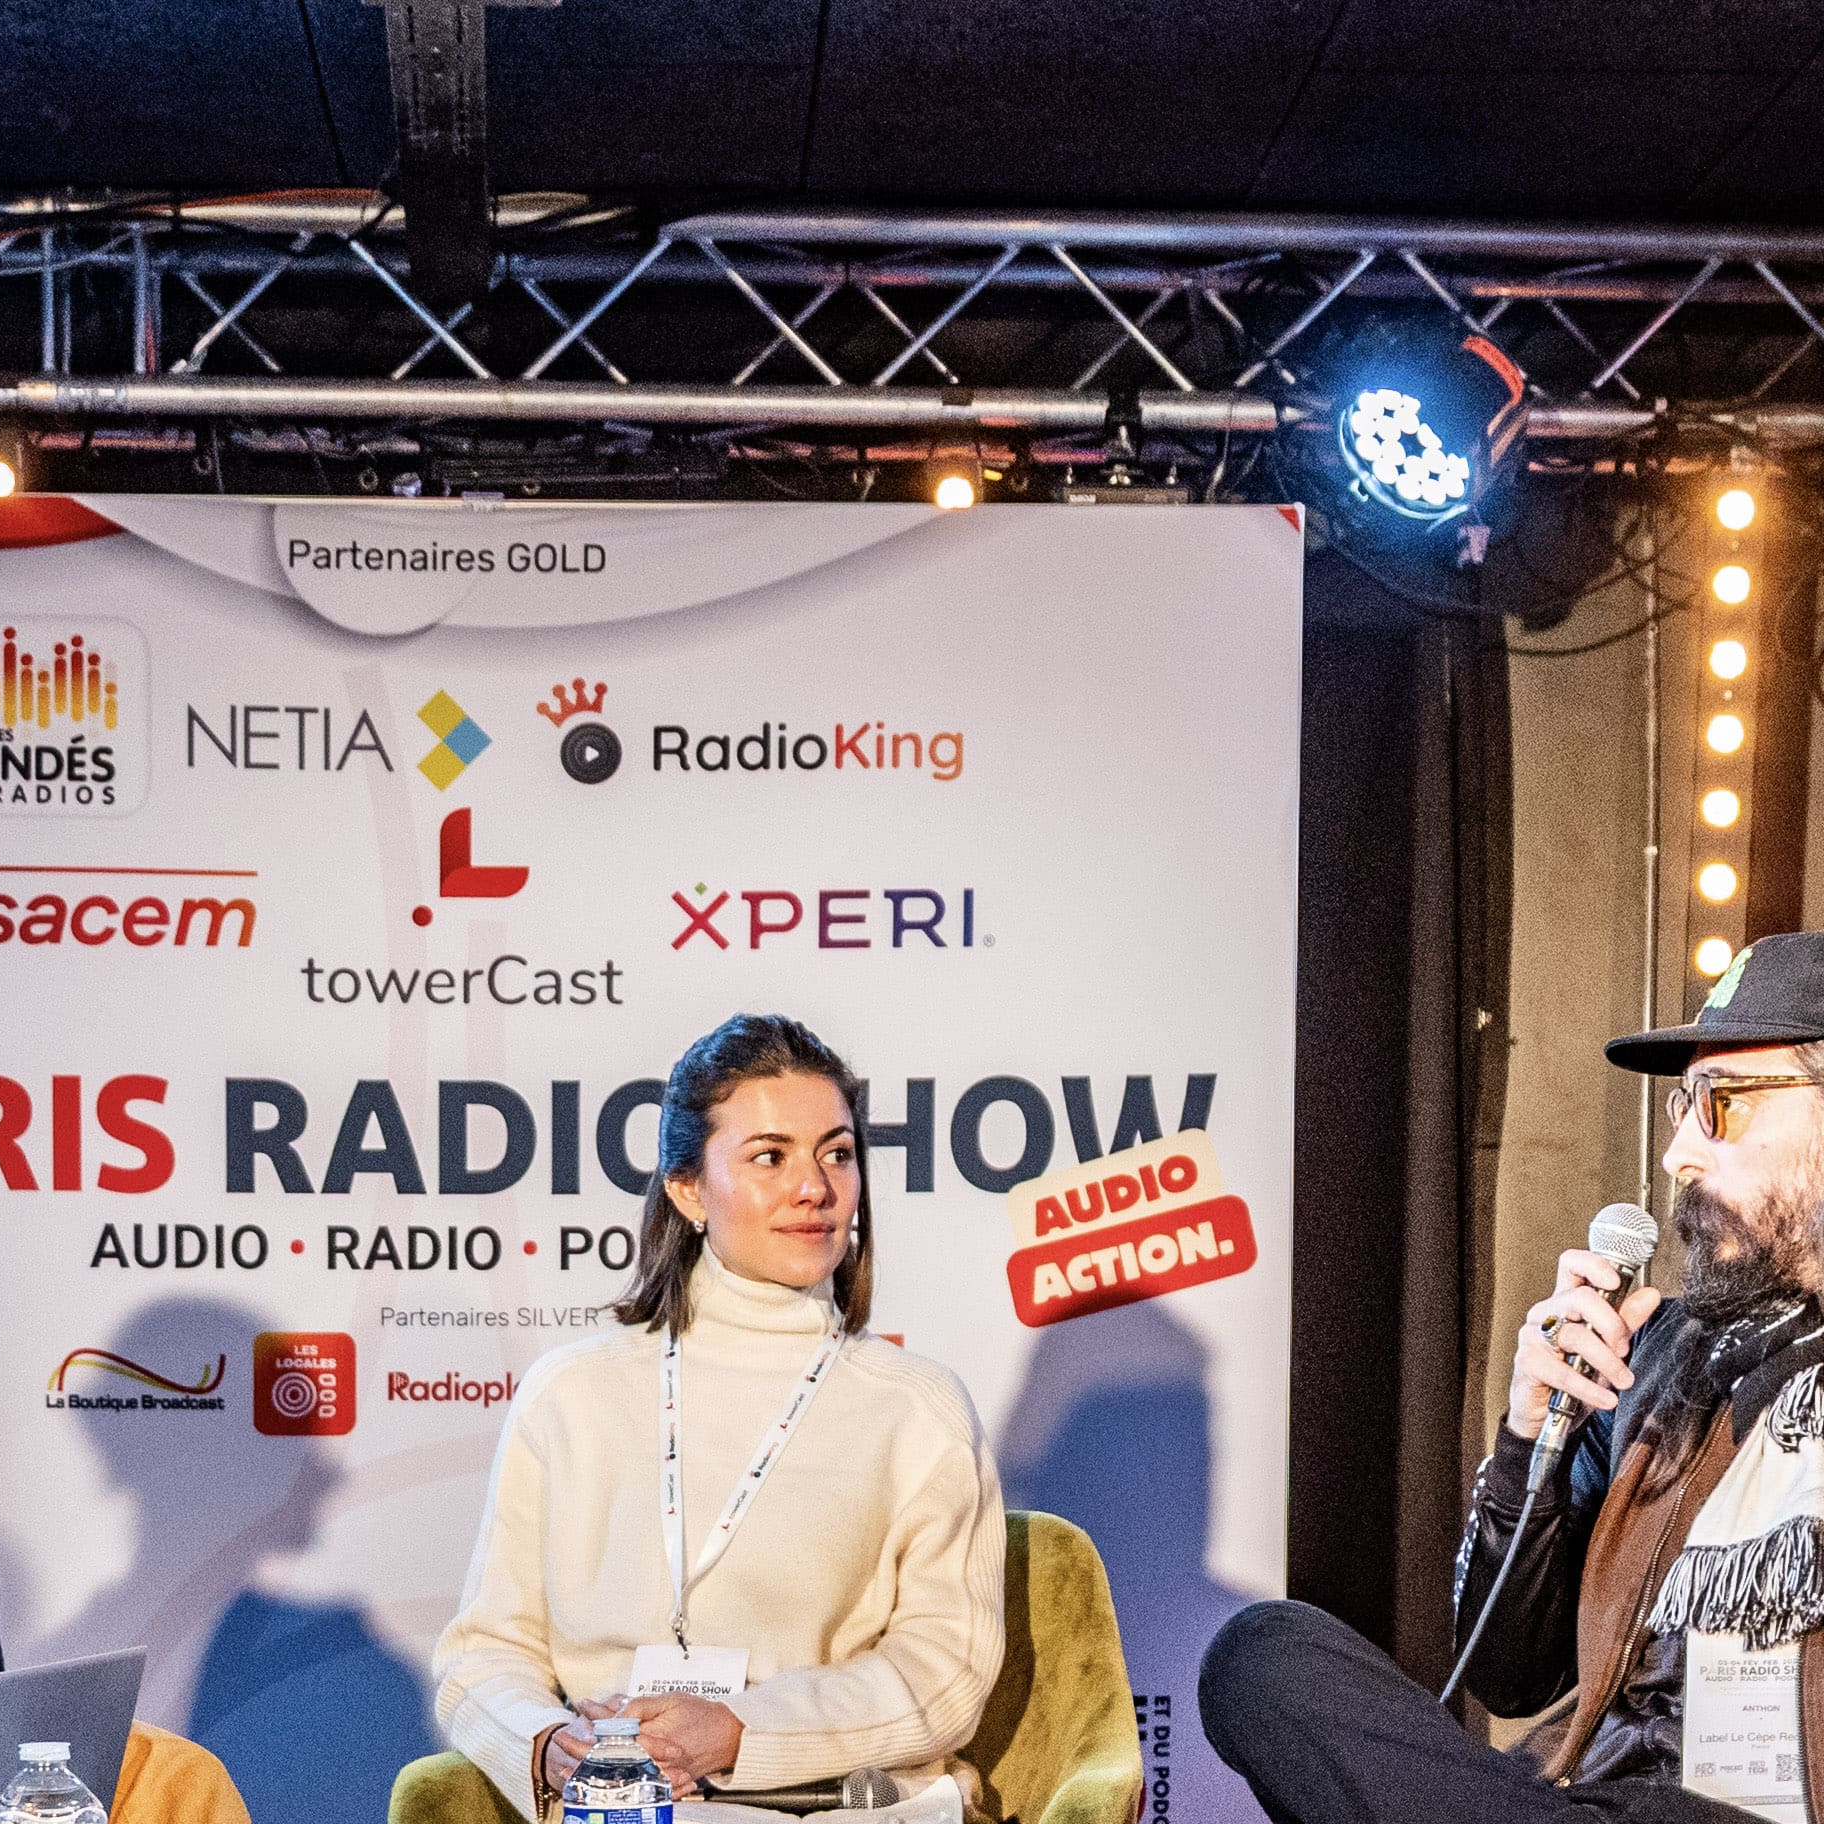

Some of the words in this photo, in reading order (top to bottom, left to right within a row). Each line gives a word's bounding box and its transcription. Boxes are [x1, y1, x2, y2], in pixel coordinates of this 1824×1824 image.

[288, 540, 496, 573] Partenaires
[506, 542, 608, 574] GOLD
[186, 703, 395, 773] NETIA
[651, 722, 965, 782] RadioKing
[670, 887, 975, 950] XPERI
[302, 955, 624, 1006] towerCast
[225, 1076, 666, 1195] RADIO
[861, 1072, 1218, 1194] HOW
[1034, 1154, 1198, 1238] AUDIO
[91, 1222, 268, 1270] AUDIO
[327, 1225, 502, 1271] RADIO
[1032, 1221, 1234, 1305] ACTION.
[380, 1306, 510, 1327] Partenaires
[517, 1307, 599, 1327] SILVER
[275, 1357, 337, 1369] LOCALES
[293, 1344, 319, 1356] LES
[46, 1394, 65, 1409] La
[68, 1394, 139, 1412] Boutique
[141, 1394, 225, 1410] Broadcast
[387, 1371, 519, 1408] Radiopl
[1700, 1666, 1737, 1676] PRIS
[1741, 1666, 1781, 1676] RADIO
[639, 1685, 666, 1693] PRIS
[702, 1686, 732, 1695] SHOW
[1154, 1695, 1171, 1718] ET
[1153, 1725, 1171, 1757] DU
[1699, 1733, 1729, 1744] Label
[1732, 1733, 1744, 1742] Le
